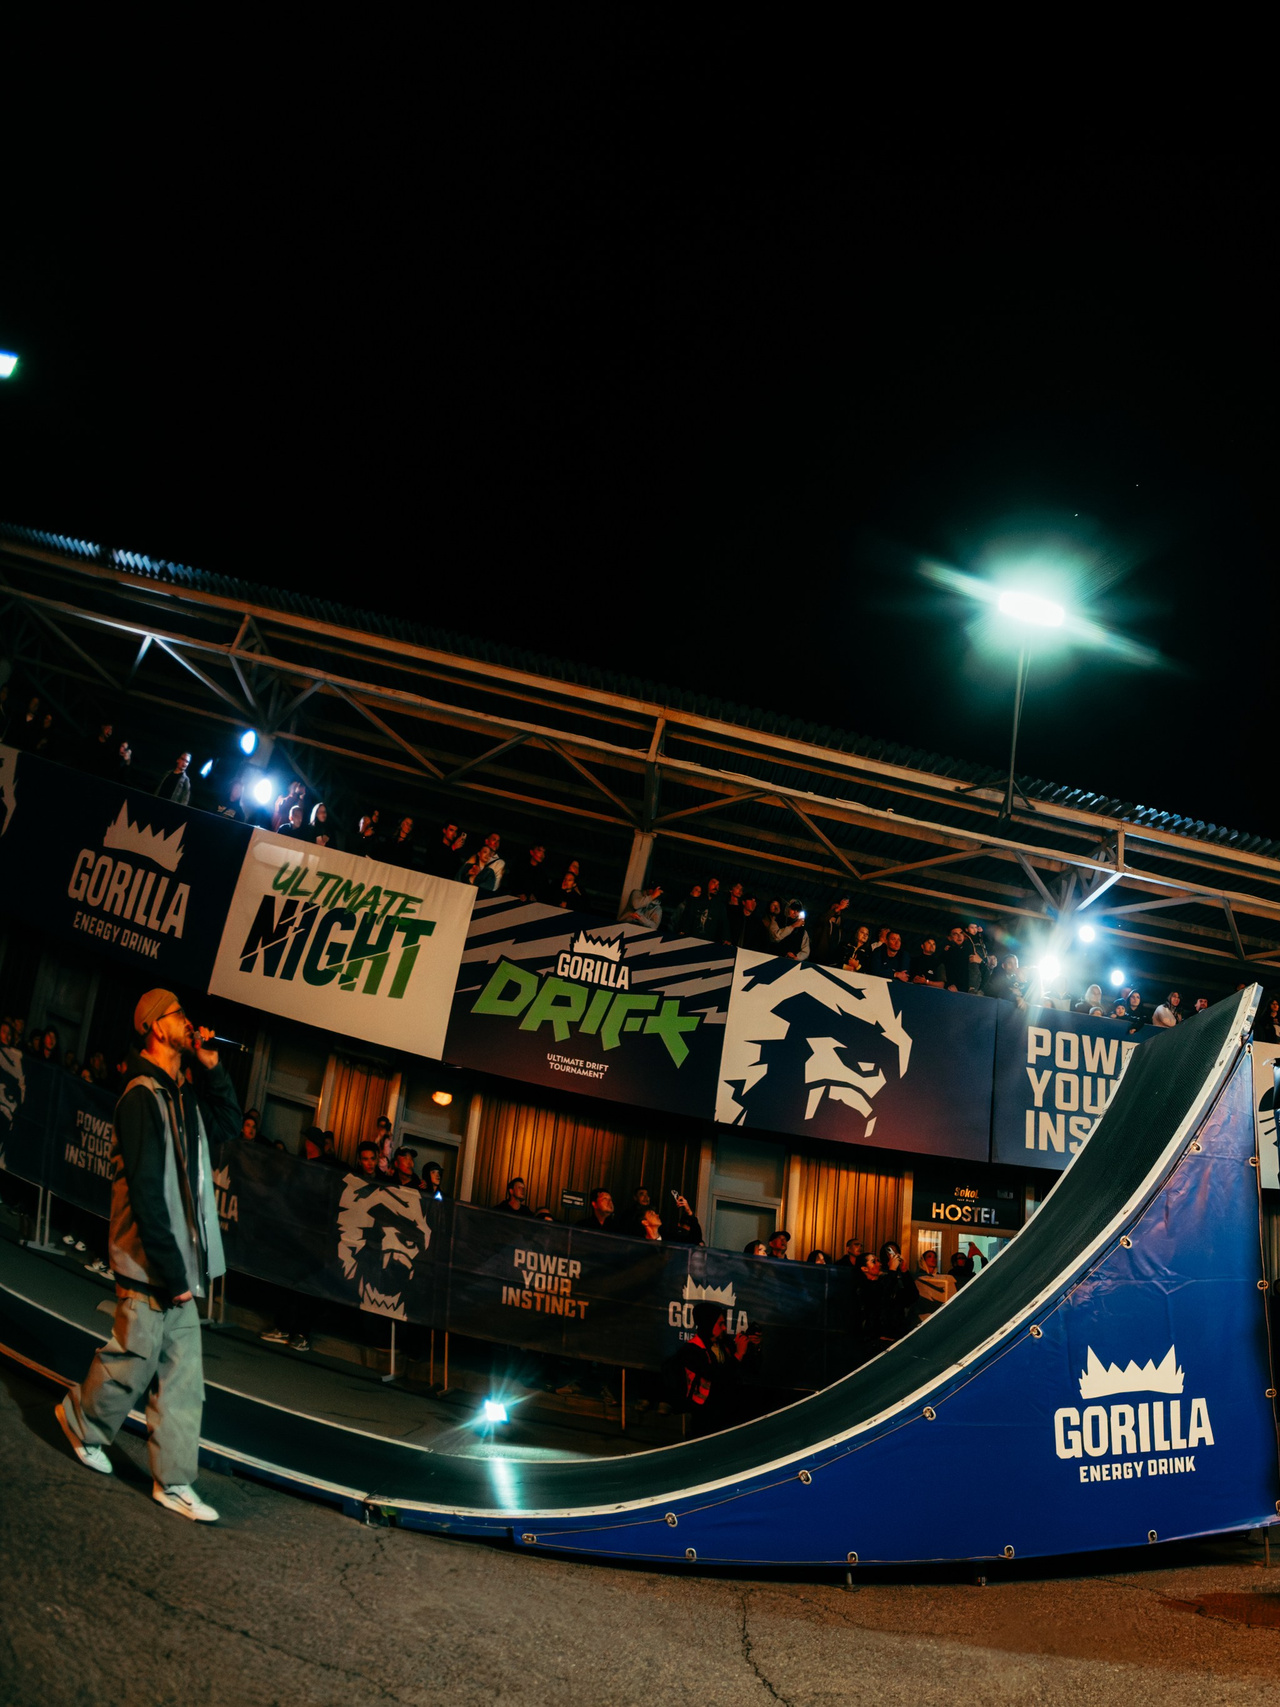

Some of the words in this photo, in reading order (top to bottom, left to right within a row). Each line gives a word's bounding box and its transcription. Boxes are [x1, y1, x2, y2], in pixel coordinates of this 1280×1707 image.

[67, 847, 191, 940] GORILLA
[271, 862, 424, 925] ULTIMATE
[72, 910, 121, 944] ENERGY
[120, 928, 161, 960] DRINK
[238, 894, 437, 999] NIGHT
[556, 952, 630, 990] GORILLA
[470, 959, 701, 1069] DRIFT
[546, 1052, 585, 1068] ULTIMATE
[585, 1060, 609, 1072] DRIFT
[1026, 1025, 1141, 1076] POW
[549, 1061, 605, 1080] TOURNAMENT
[1025, 1066, 1118, 1115] YOU
[75, 1109, 115, 1142] POWE
[64, 1142, 115, 1181] INSTINC
[81, 1131, 112, 1161] YOUR
[931, 1201, 1000, 1225] HOSTEL
[513, 1248, 582, 1280] POWER
[501, 1285, 590, 1320] INSTINCT
[521, 1269, 572, 1298] YOUR
[1053, 1397, 1215, 1460] GORILLA
[1078, 1460, 1144, 1483] ENERGY
[1147, 1455, 1196, 1477] DRINK
